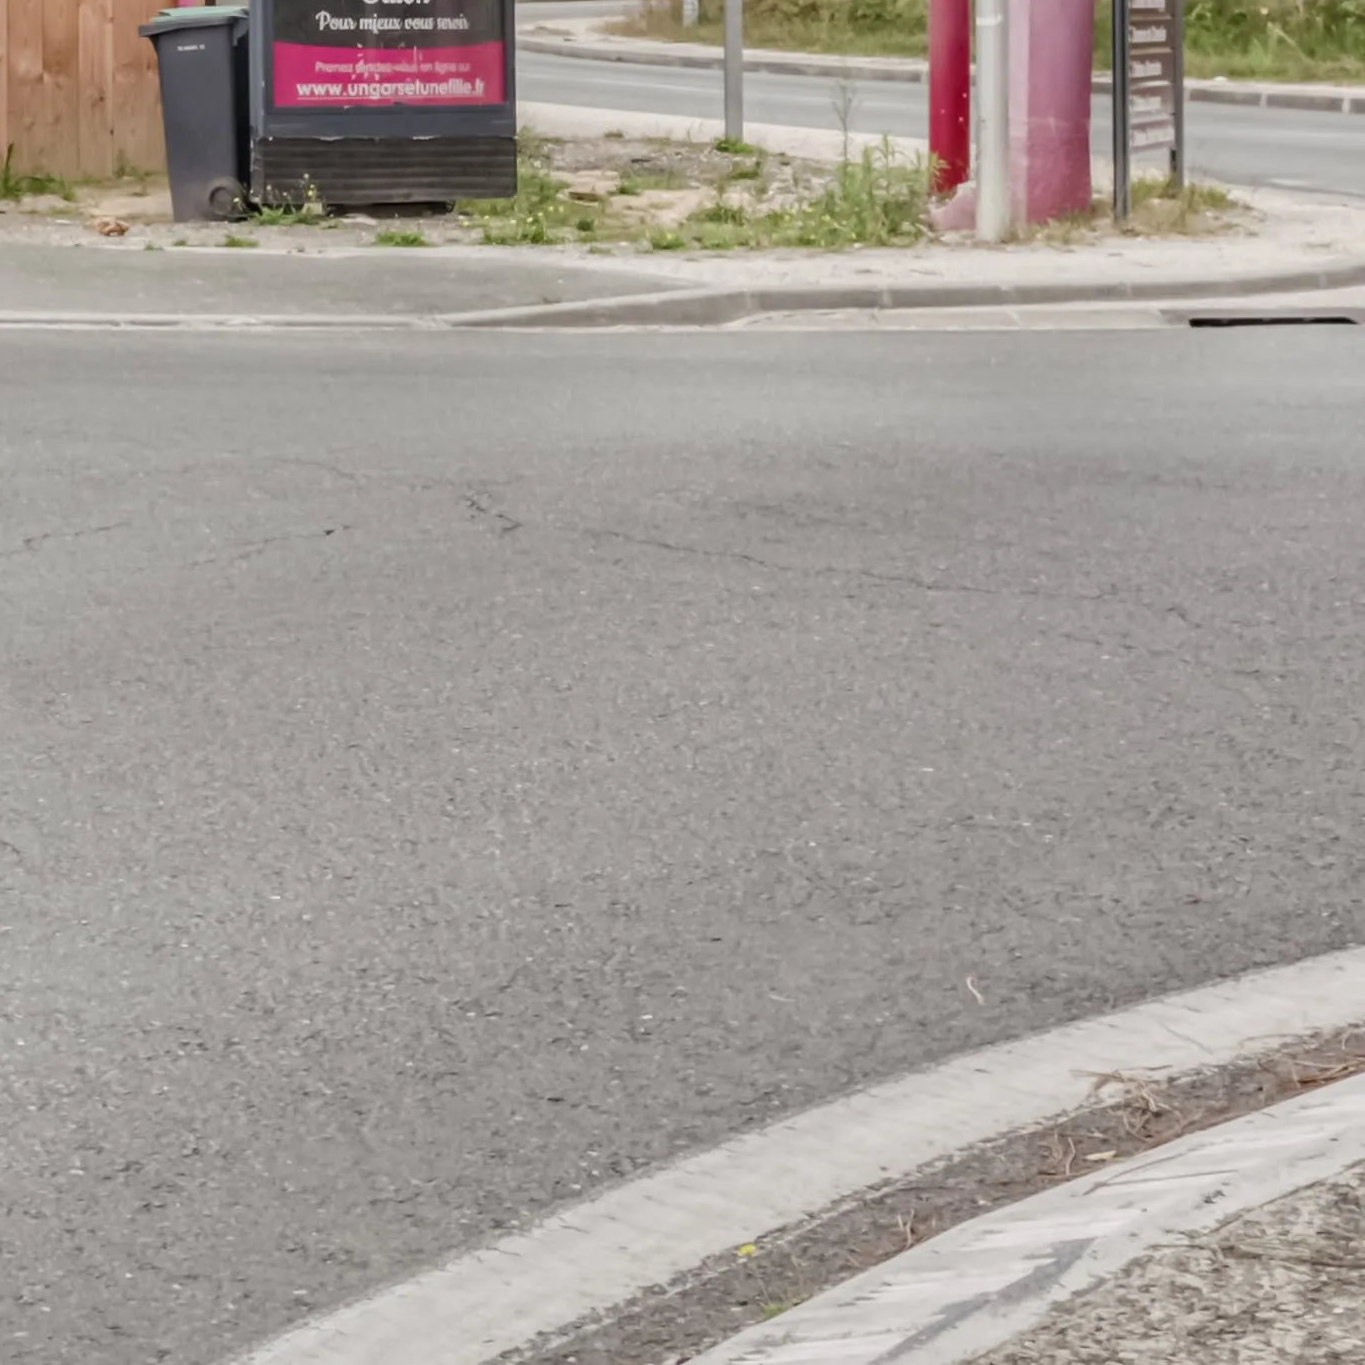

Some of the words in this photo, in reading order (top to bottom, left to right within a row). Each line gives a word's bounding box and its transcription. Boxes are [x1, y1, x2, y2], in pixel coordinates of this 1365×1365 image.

[315, 10, 356, 31] Pour
[359, 13, 402, 34] mieux
[405, 17, 435, 30] vous
